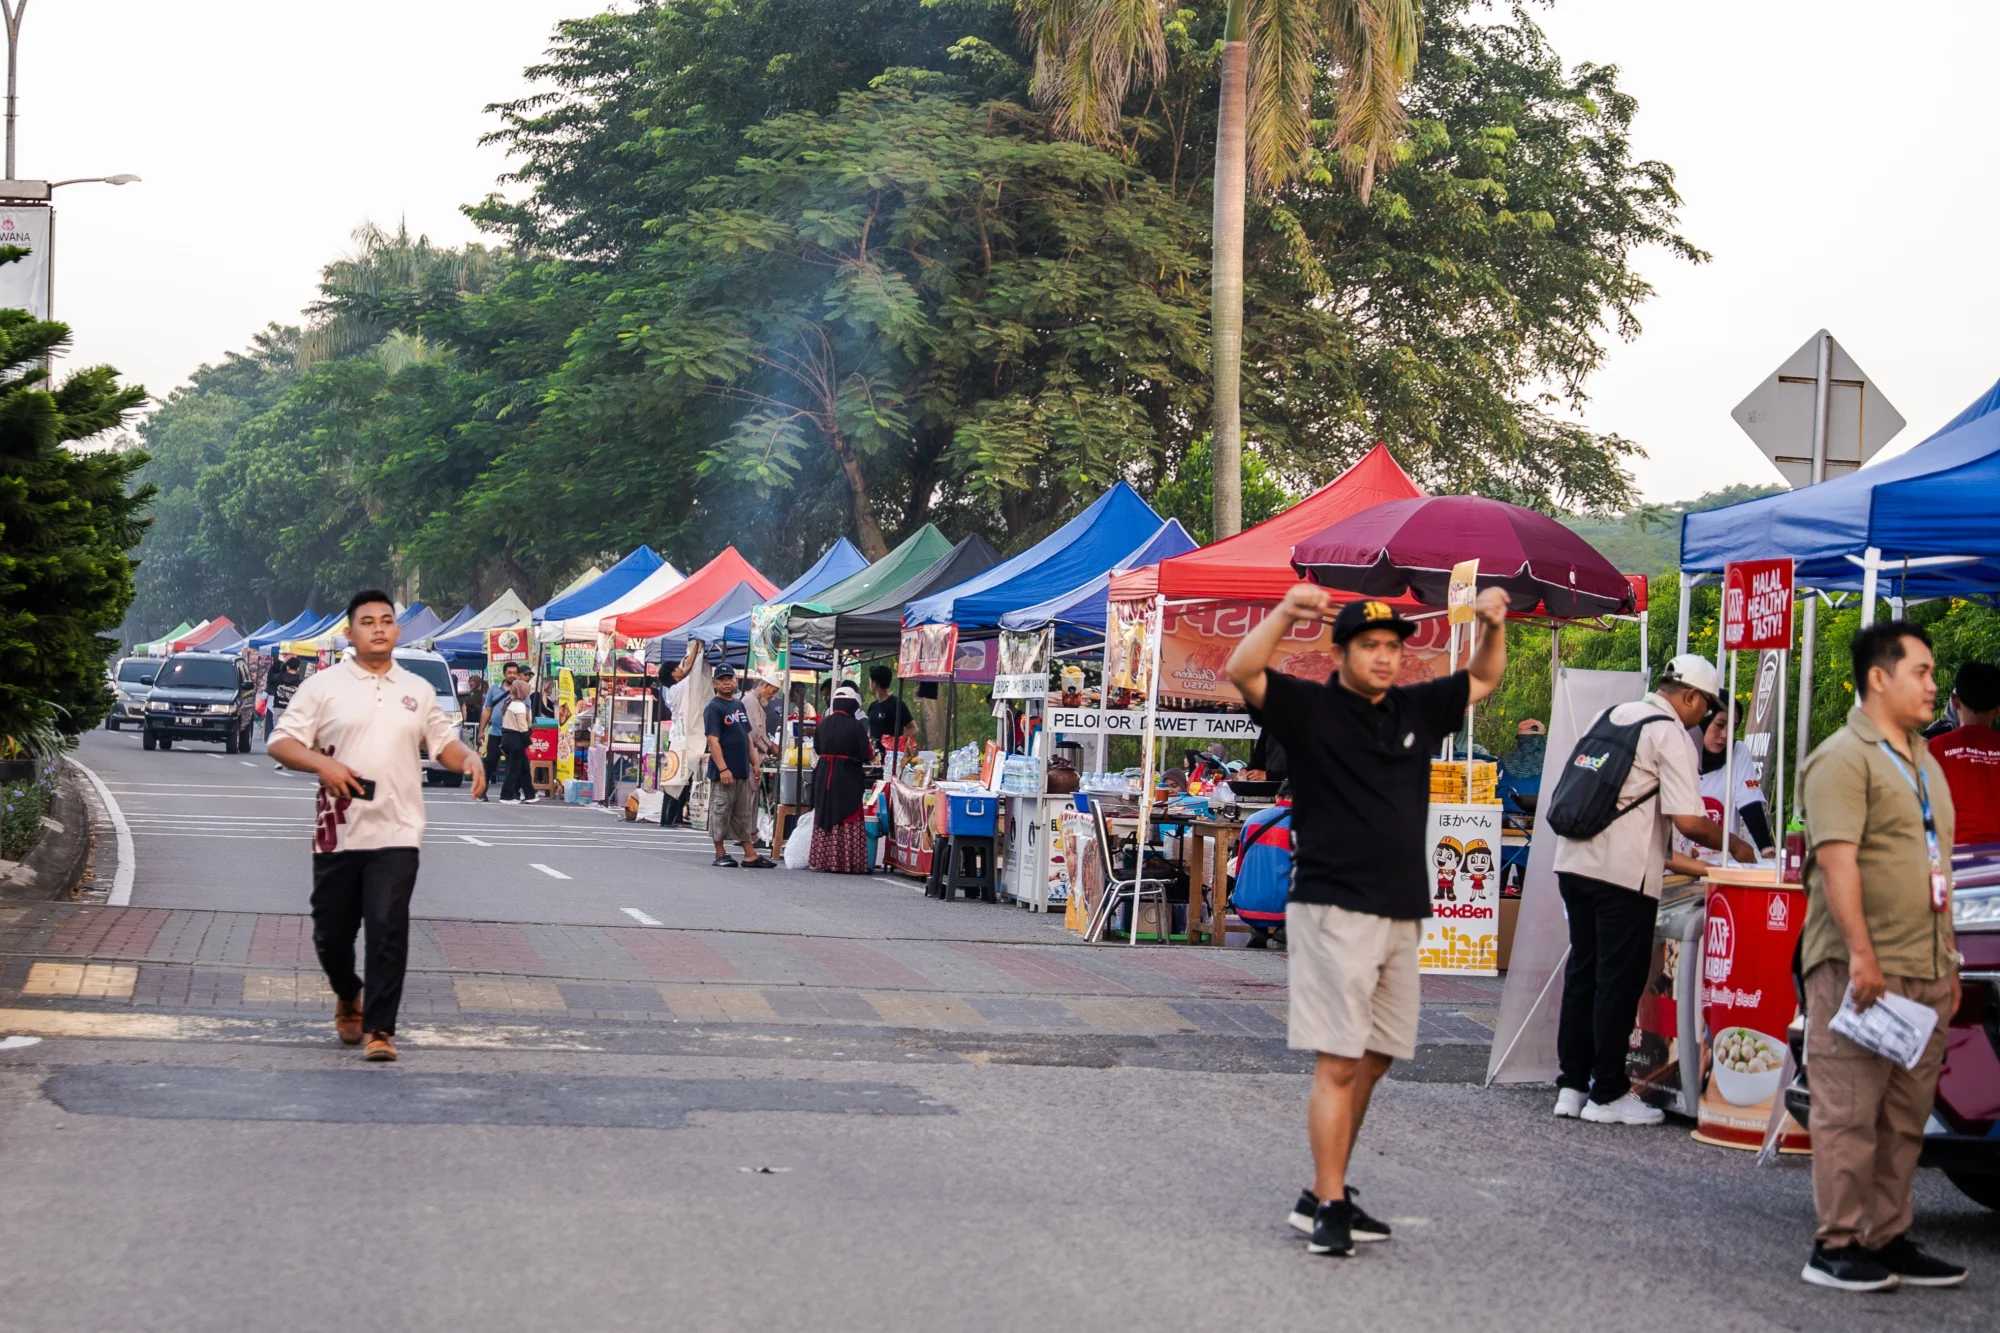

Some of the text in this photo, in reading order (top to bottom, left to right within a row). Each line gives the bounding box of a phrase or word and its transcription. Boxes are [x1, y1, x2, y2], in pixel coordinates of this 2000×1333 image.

[1752, 568, 1782, 596] HALAL
[1747, 588, 1790, 620] HEALTHY
[1752, 613, 1782, 640] TASTY!
[1205, 718, 1256, 733] TANPA
[1439, 813, 1492, 828] ほかべん
[1430, 903, 1493, 919] HokBen
[1705, 955, 1733, 982] KIBIF
[1711, 985, 1735, 1009] Quality
[1735, 988, 1762, 1008] Beef
